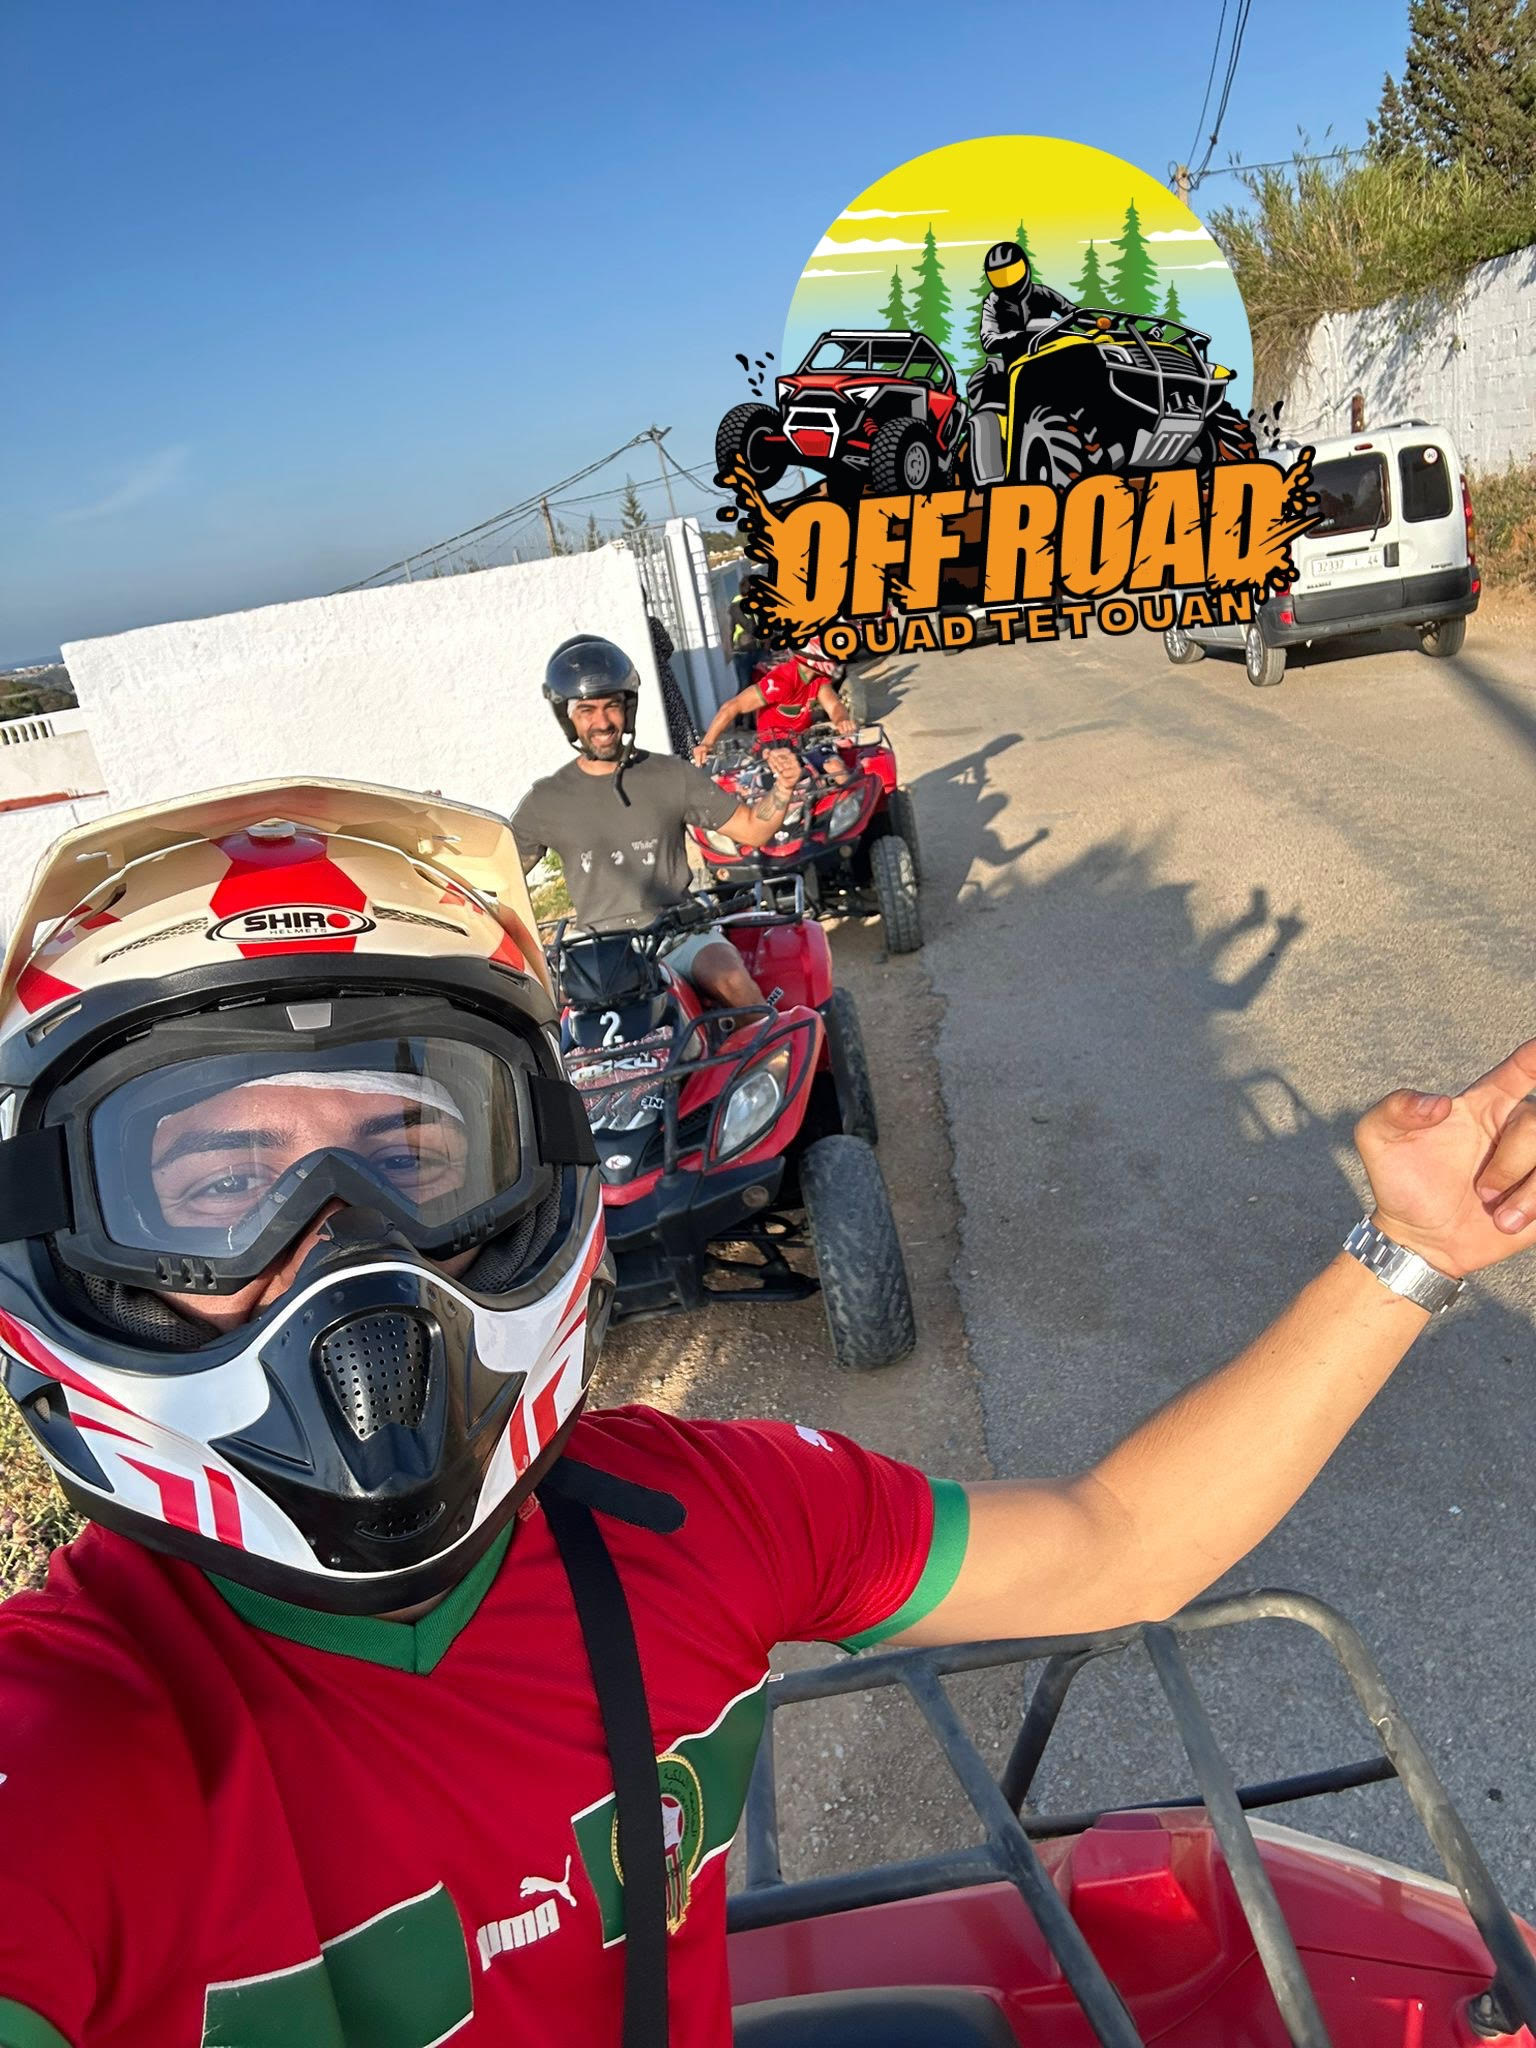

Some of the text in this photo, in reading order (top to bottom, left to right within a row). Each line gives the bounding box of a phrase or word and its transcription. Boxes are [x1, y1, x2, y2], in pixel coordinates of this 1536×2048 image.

[245, 912, 351, 933] SHIRO
[269, 927, 328, 935] HELMETS
[599, 1010, 624, 1053] 2
[476, 1898, 561, 1972] PUMA
